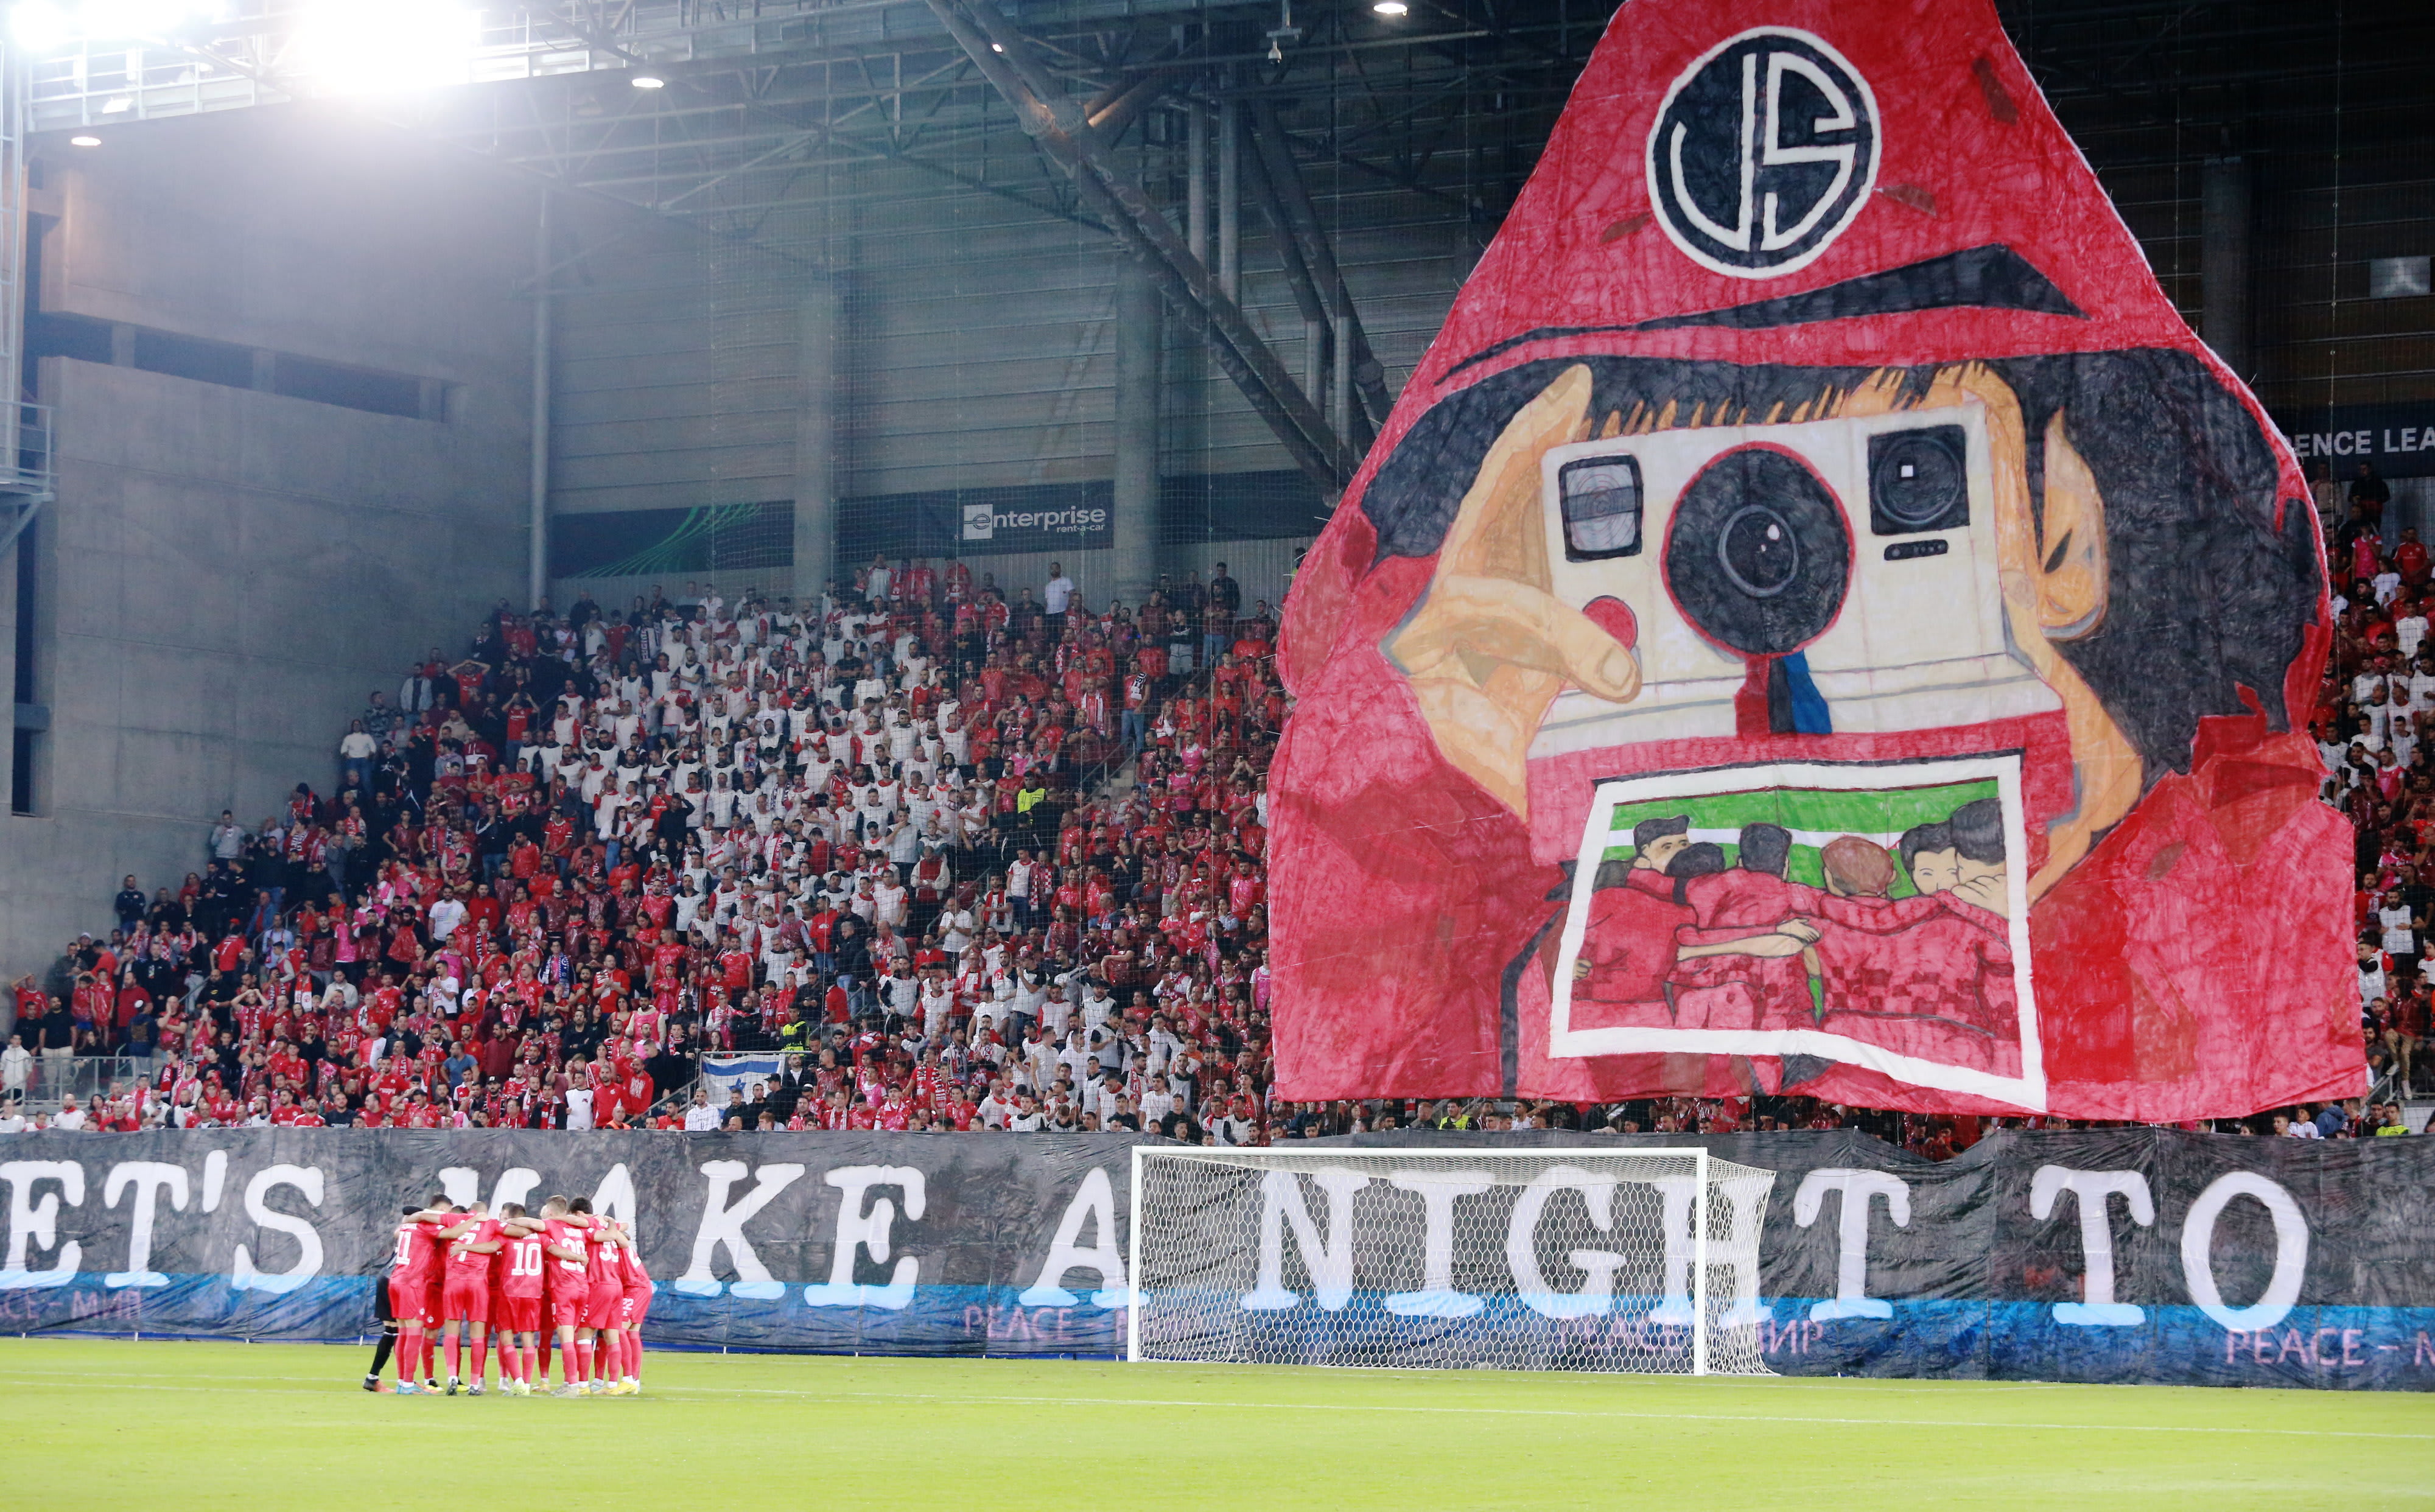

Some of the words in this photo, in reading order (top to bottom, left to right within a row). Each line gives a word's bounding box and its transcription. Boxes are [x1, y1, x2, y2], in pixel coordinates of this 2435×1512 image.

[964, 505, 1106, 537] enterprise
[1057, 523, 1105, 533] rent-a-car
[511, 1242, 542, 1276] 10
[1018, 1166, 1151, 1308] A
[1240, 1164, 1911, 1327] NIGHT
[2030, 1164, 2309, 1331] TO
[964, 1305, 1073, 1340] PEACE
[2225, 1327, 2365, 1366] PEACE
